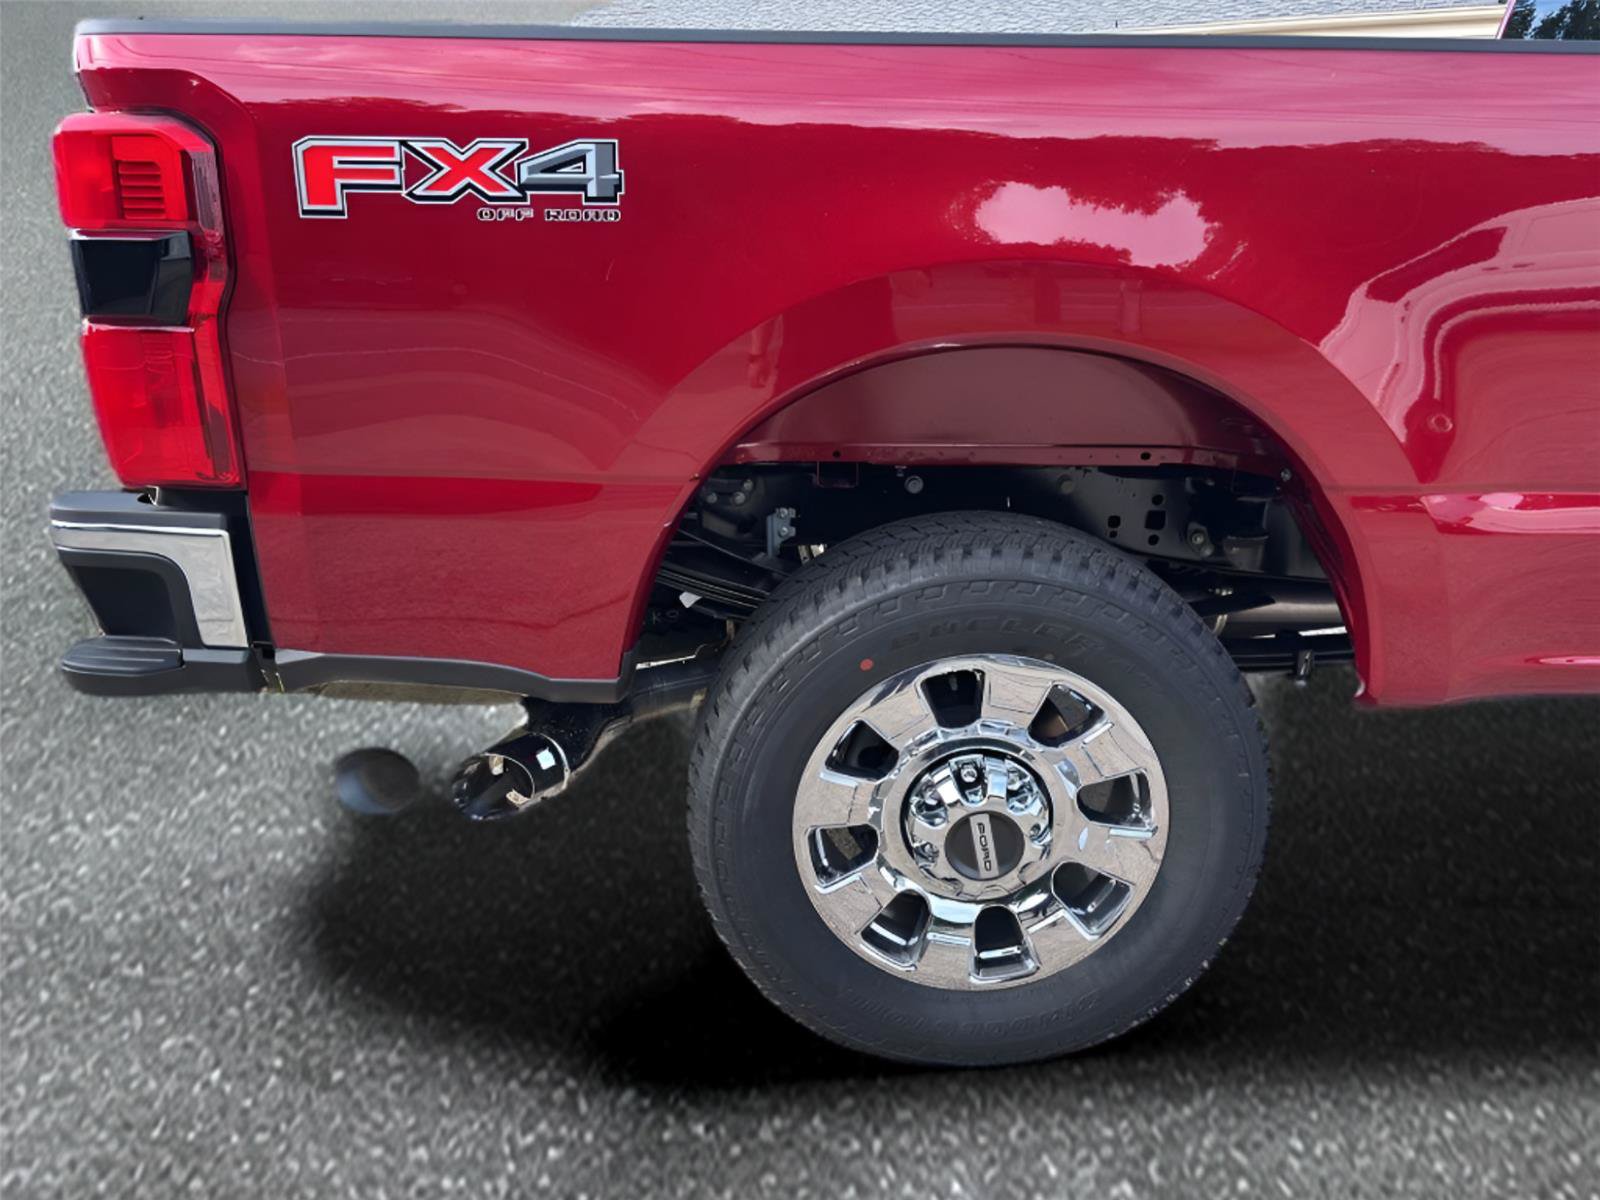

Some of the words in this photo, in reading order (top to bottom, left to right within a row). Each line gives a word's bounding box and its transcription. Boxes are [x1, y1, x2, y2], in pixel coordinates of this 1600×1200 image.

[292, 135, 625, 219] FX4
[477, 208, 534, 221] OFF
[544, 208, 621, 222] ROAD
[976, 822, 992, 872] FORD
